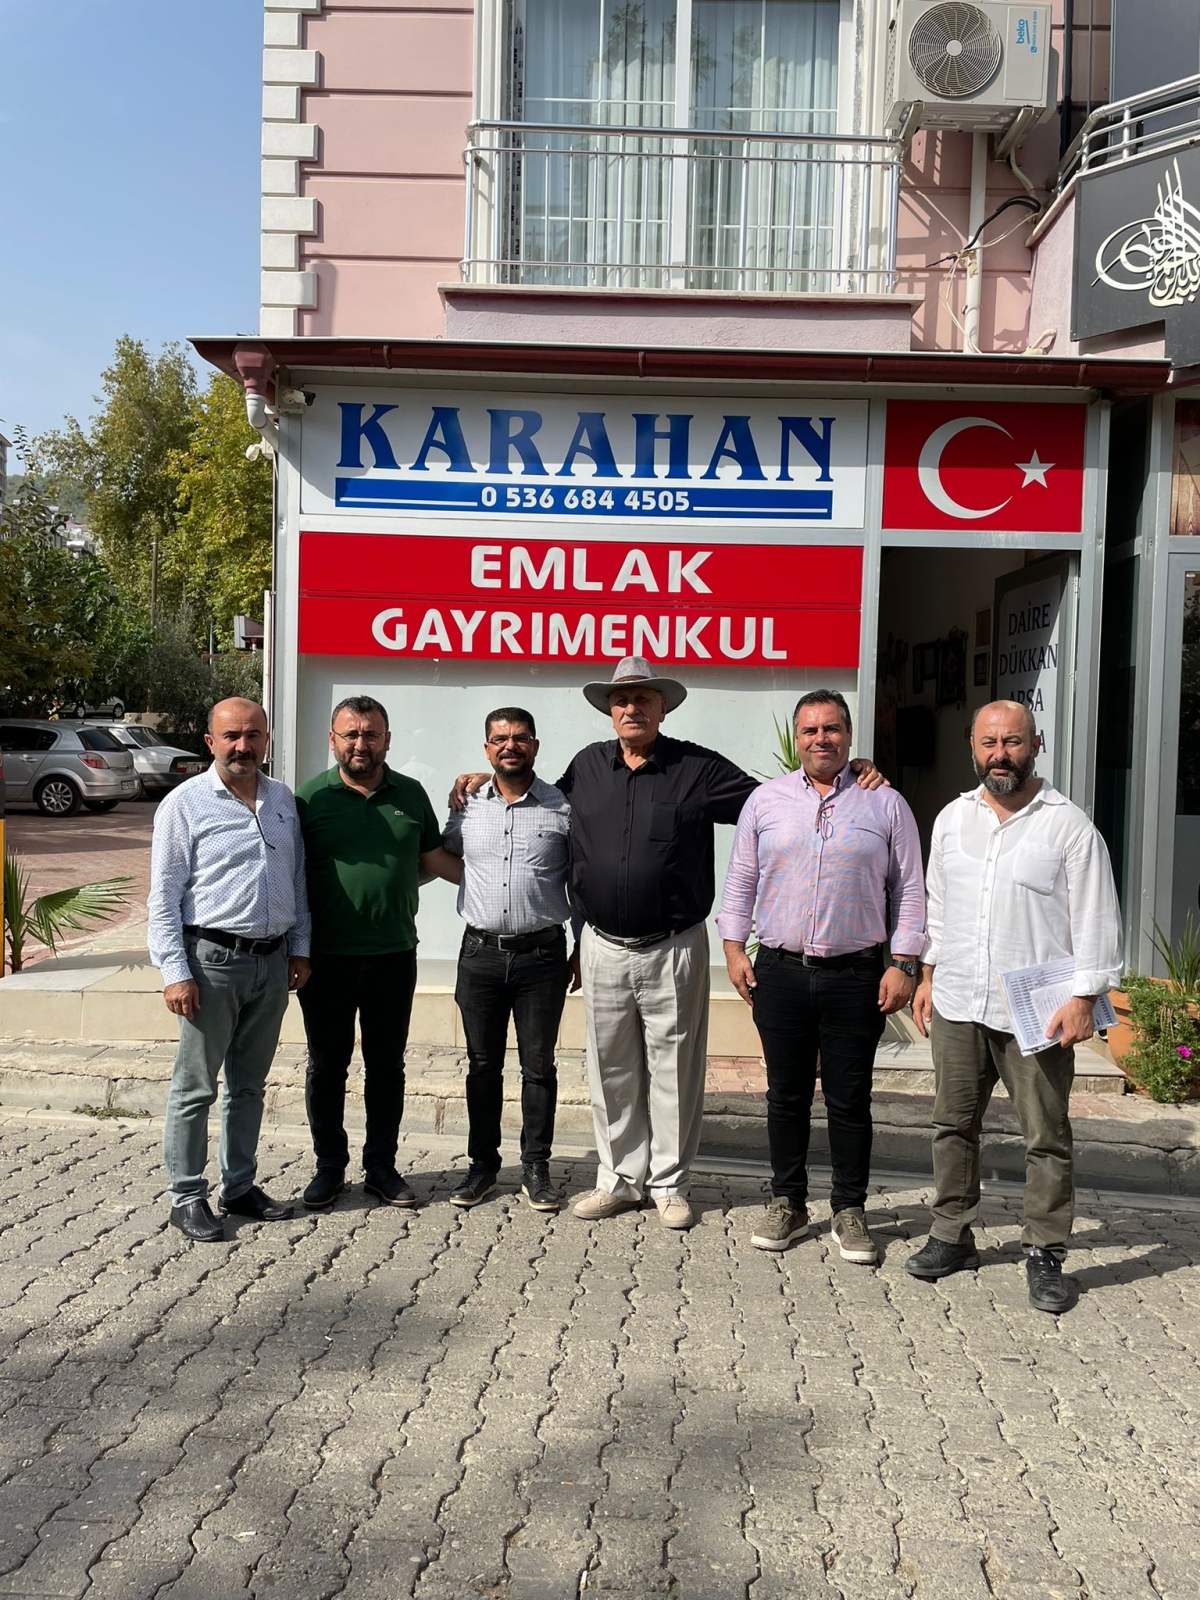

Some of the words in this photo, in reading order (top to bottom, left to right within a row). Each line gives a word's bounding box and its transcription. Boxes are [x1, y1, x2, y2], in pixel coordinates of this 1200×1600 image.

[1016, 19, 1025, 44] beko
[336, 403, 834, 483] KARAHAN
[481, 486, 497, 507] 0
[506, 487, 555, 509] 536
[563, 488, 615, 510] 684
[624, 490, 690, 511] 4505
[470, 545, 713, 594] EMLAK
[371, 607, 787, 660] GAYRIMENKUL
[1008, 601, 1050, 636] DAİRE
[999, 643, 1058, 676] DÜKKAN
